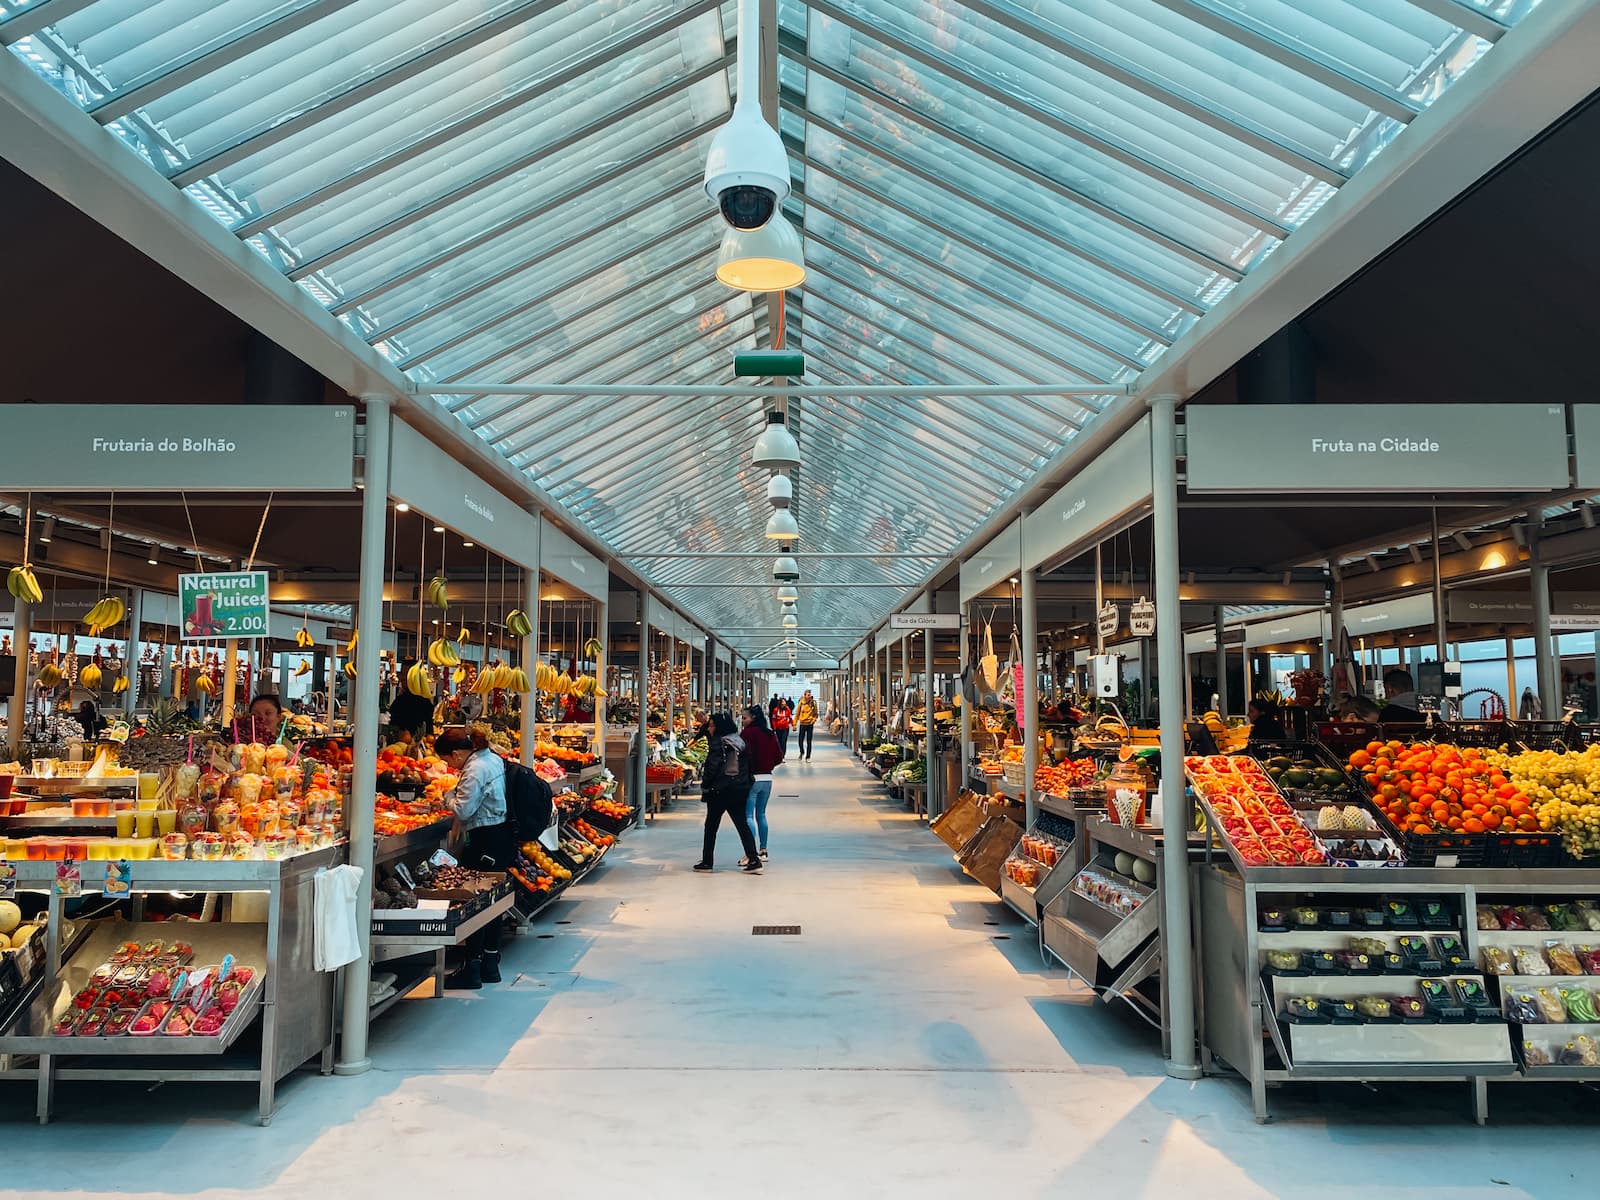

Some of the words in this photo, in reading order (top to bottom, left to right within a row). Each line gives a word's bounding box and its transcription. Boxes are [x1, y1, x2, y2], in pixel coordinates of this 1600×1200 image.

[92, 438, 154, 452] Frutaria
[158, 437, 179, 452] do
[182, 438, 237, 452] Bolhão
[1311, 438, 1354, 453] Fruta
[1358, 442, 1377, 452] na
[1380, 437, 1440, 452] Cidade
[184, 574, 257, 591] Natural
[216, 591, 266, 609] Juices
[910, 616, 916, 624] da
[917, 615, 936, 624] Glória
